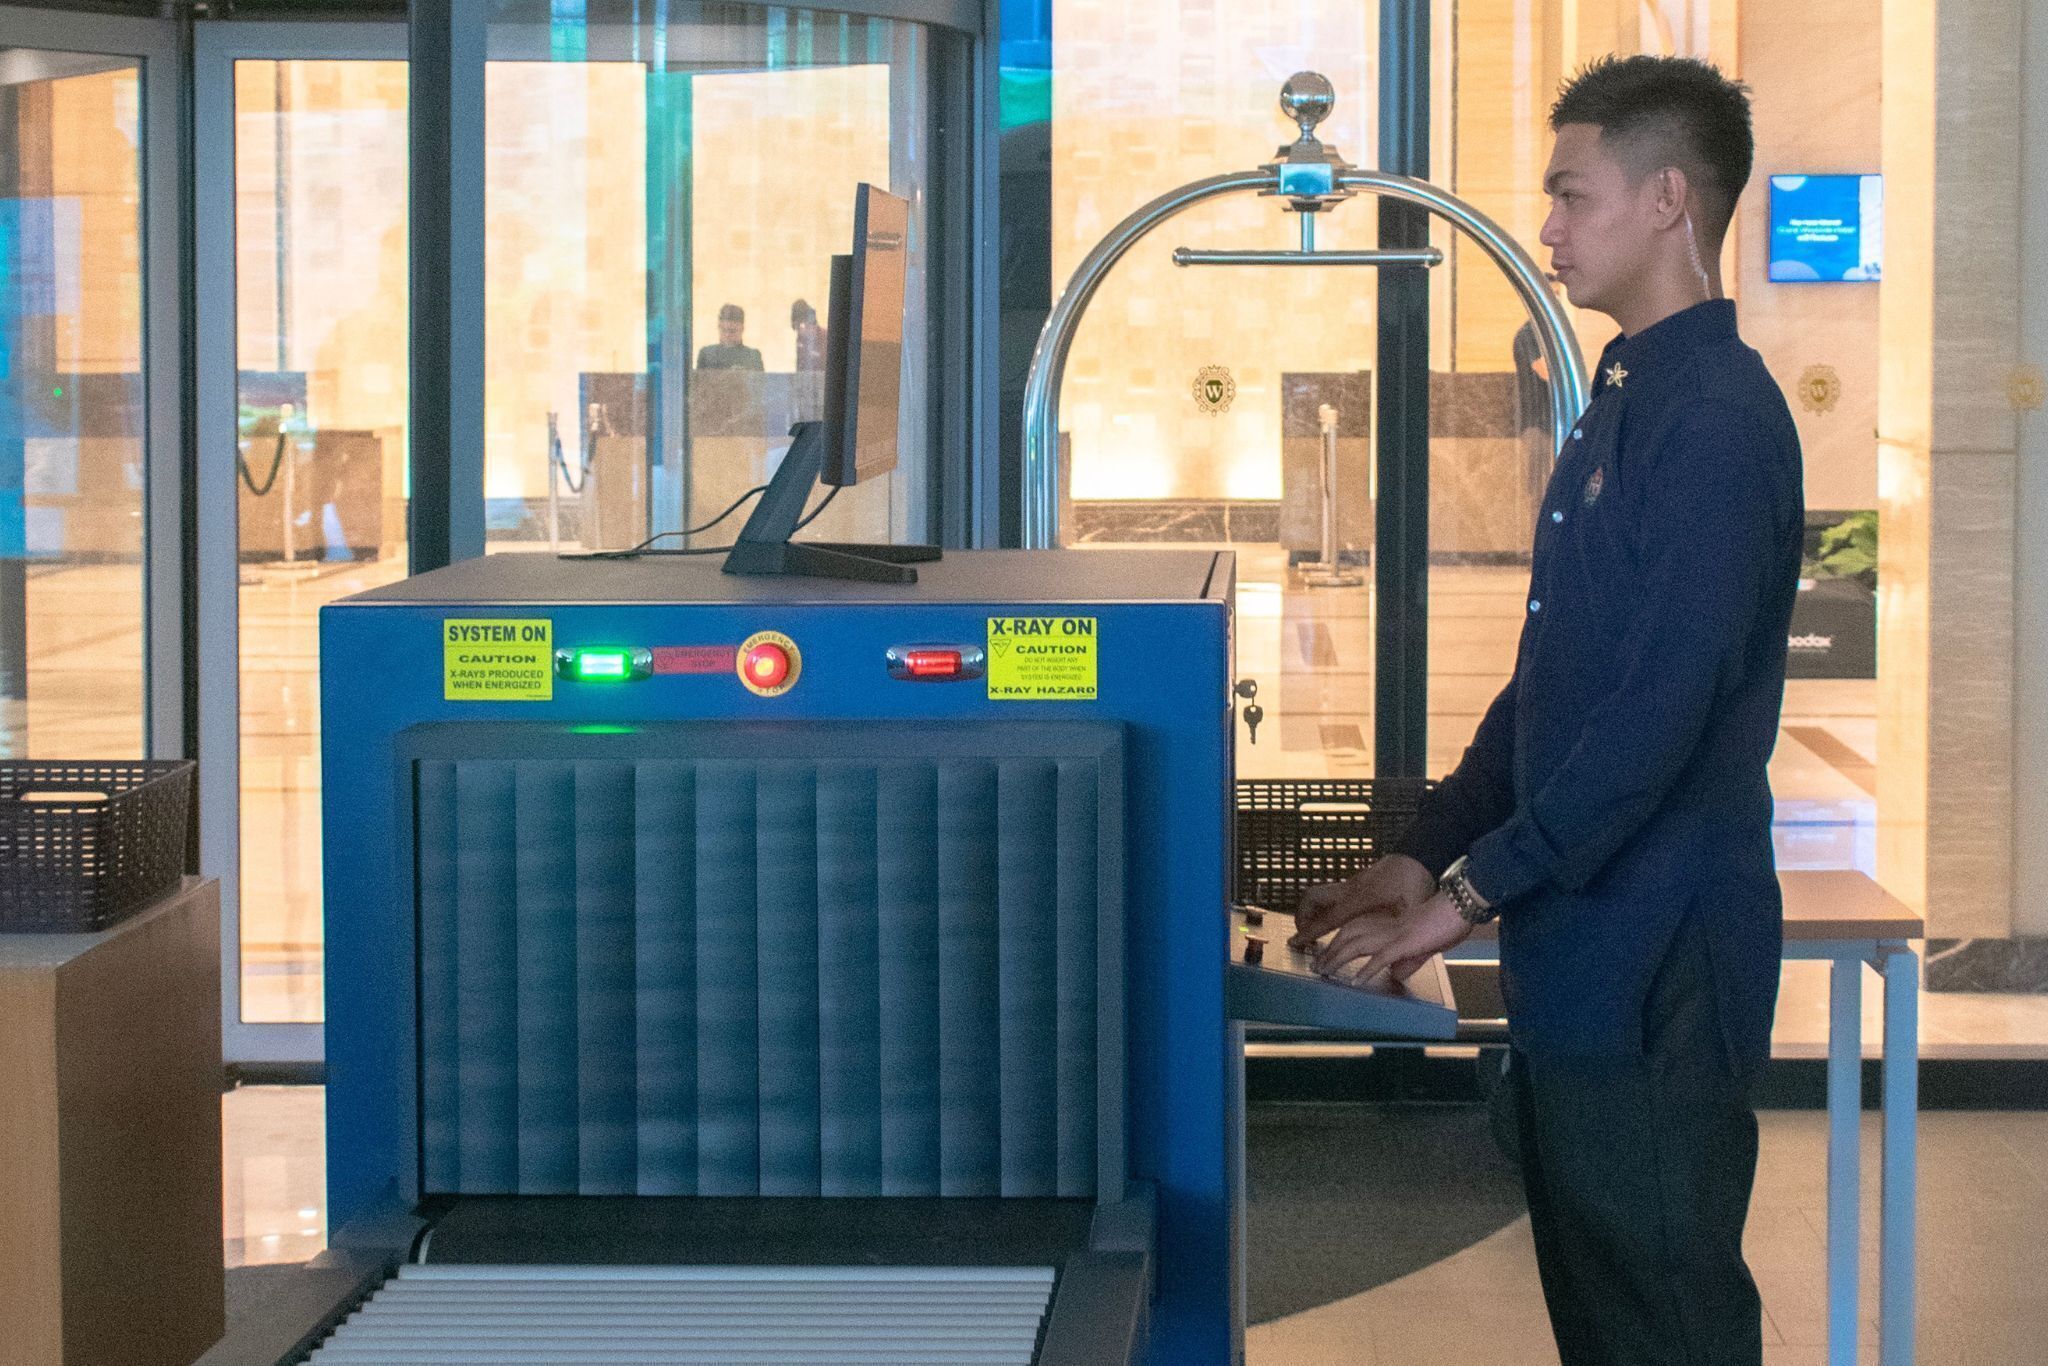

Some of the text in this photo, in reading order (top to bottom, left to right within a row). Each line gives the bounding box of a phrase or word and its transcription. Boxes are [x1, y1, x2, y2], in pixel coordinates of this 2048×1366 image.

[992, 619, 1092, 635] X-RAY ON
[449, 626, 546, 641] SYSTEM ON
[1016, 645, 1087, 654] CAUTION
[459, 655, 536, 663] CAUTION
[450, 670, 544, 678] X-RAYS PRODUCED
[453, 681, 541, 689] WHEN ENERGIZED
[990, 686, 1095, 694] X-RAY HAZARD
